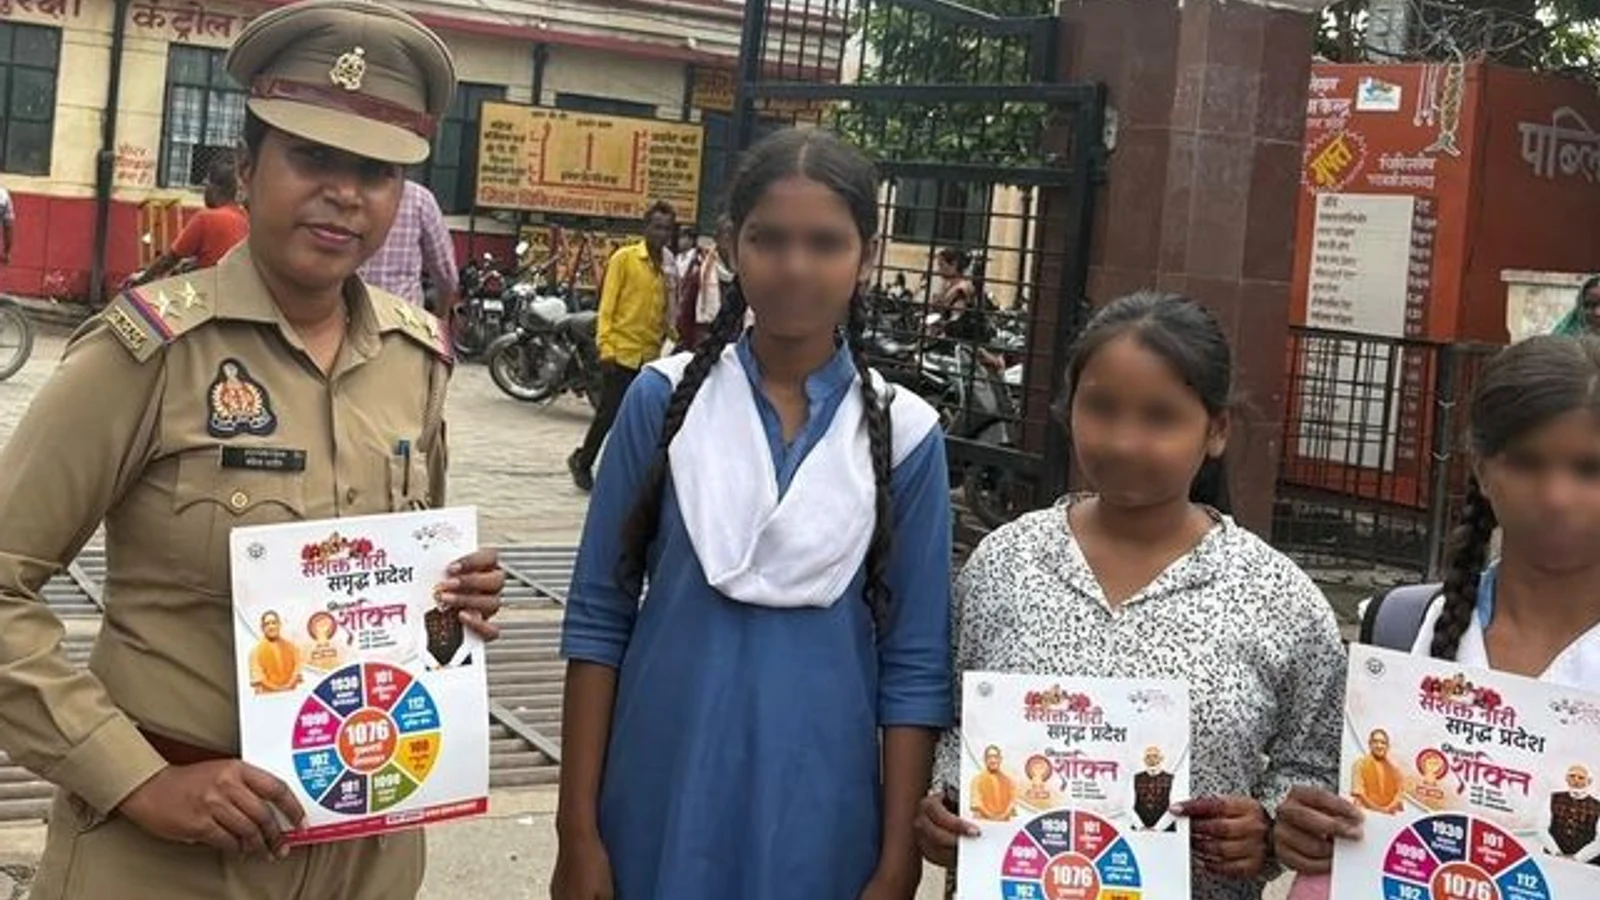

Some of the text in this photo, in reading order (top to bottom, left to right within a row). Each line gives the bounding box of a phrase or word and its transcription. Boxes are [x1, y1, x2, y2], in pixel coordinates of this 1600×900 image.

[327, 564, 413, 595] समृद्ध प्रदेश
[347, 718, 389, 746] 1076
[1047, 721, 1128, 747] समृद्ध प्रदेश
[1445, 717, 1546, 753] समृद्ध प्रदेश
[1432, 820, 1463, 840] 1930
[1482, 831, 1504, 847] 101
[1052, 865, 1093, 887] 1076
[1441, 872, 1492, 900] 1076
[1516, 873, 1538, 889] 112
